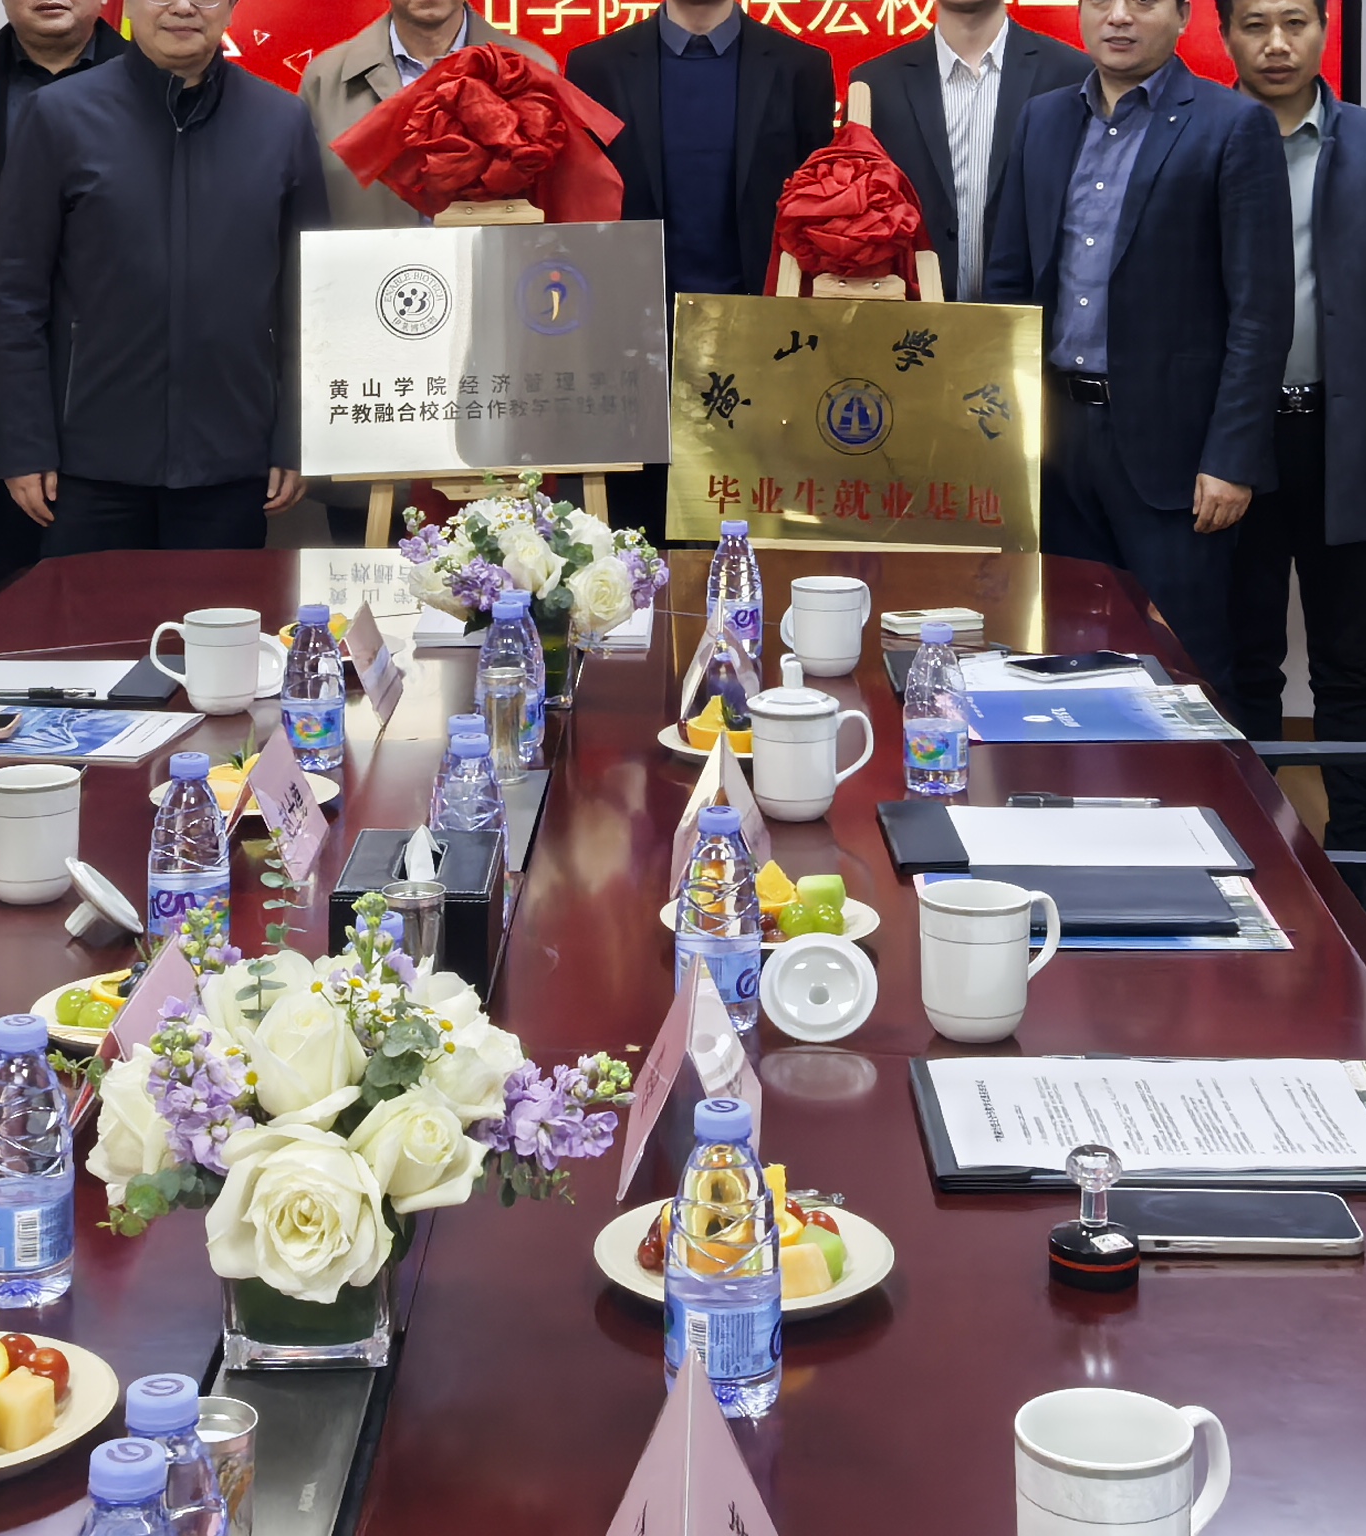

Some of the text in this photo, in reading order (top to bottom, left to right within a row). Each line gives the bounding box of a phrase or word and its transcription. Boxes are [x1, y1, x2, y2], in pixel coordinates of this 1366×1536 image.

[707, 474, 1003, 527] 毕业生就业基地
